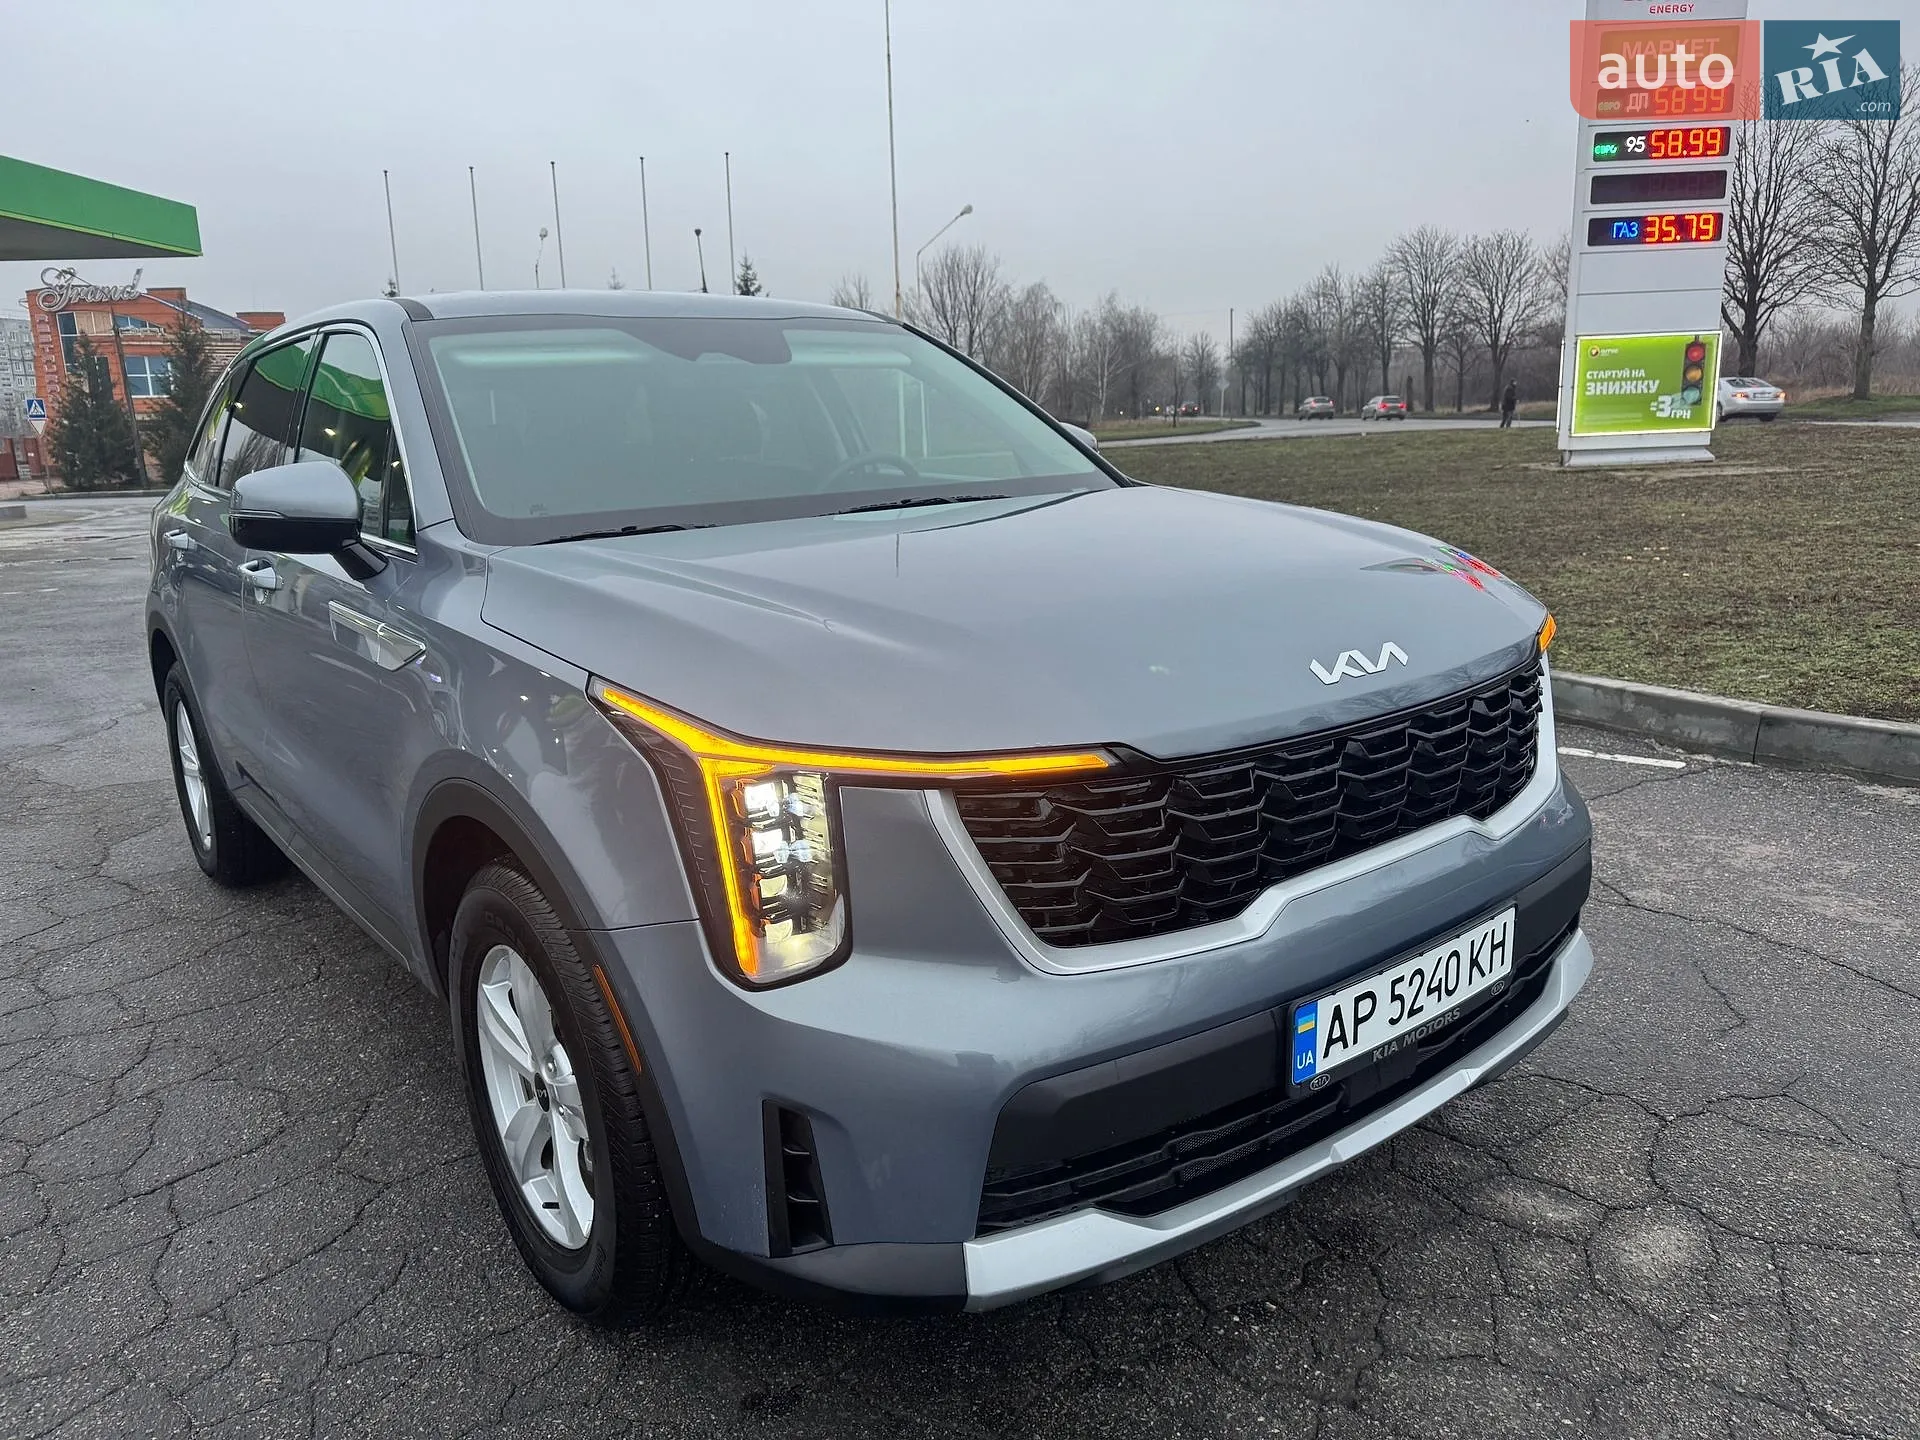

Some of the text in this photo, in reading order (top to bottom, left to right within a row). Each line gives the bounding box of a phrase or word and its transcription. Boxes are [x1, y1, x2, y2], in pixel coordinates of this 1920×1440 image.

[1649, 4, 1695, 14] ENERGY
[1626, 136, 1646, 152] 95
[1651, 129, 1721, 157] 58.99
[1613, 214, 1715, 242] ГАЗ 35.79
[1586, 368, 1645, 379] СТАРТУЙ НА
[1585, 380, 1660, 396] ЗНИЖКУ
[1671, 409, 1691, 419] ГРН
[1323, 921, 1508, 1059] AP 5240 KH
[1372, 1007, 1461, 1062] KIA MOTORS
[1297, 1050, 1314, 1070] UA
